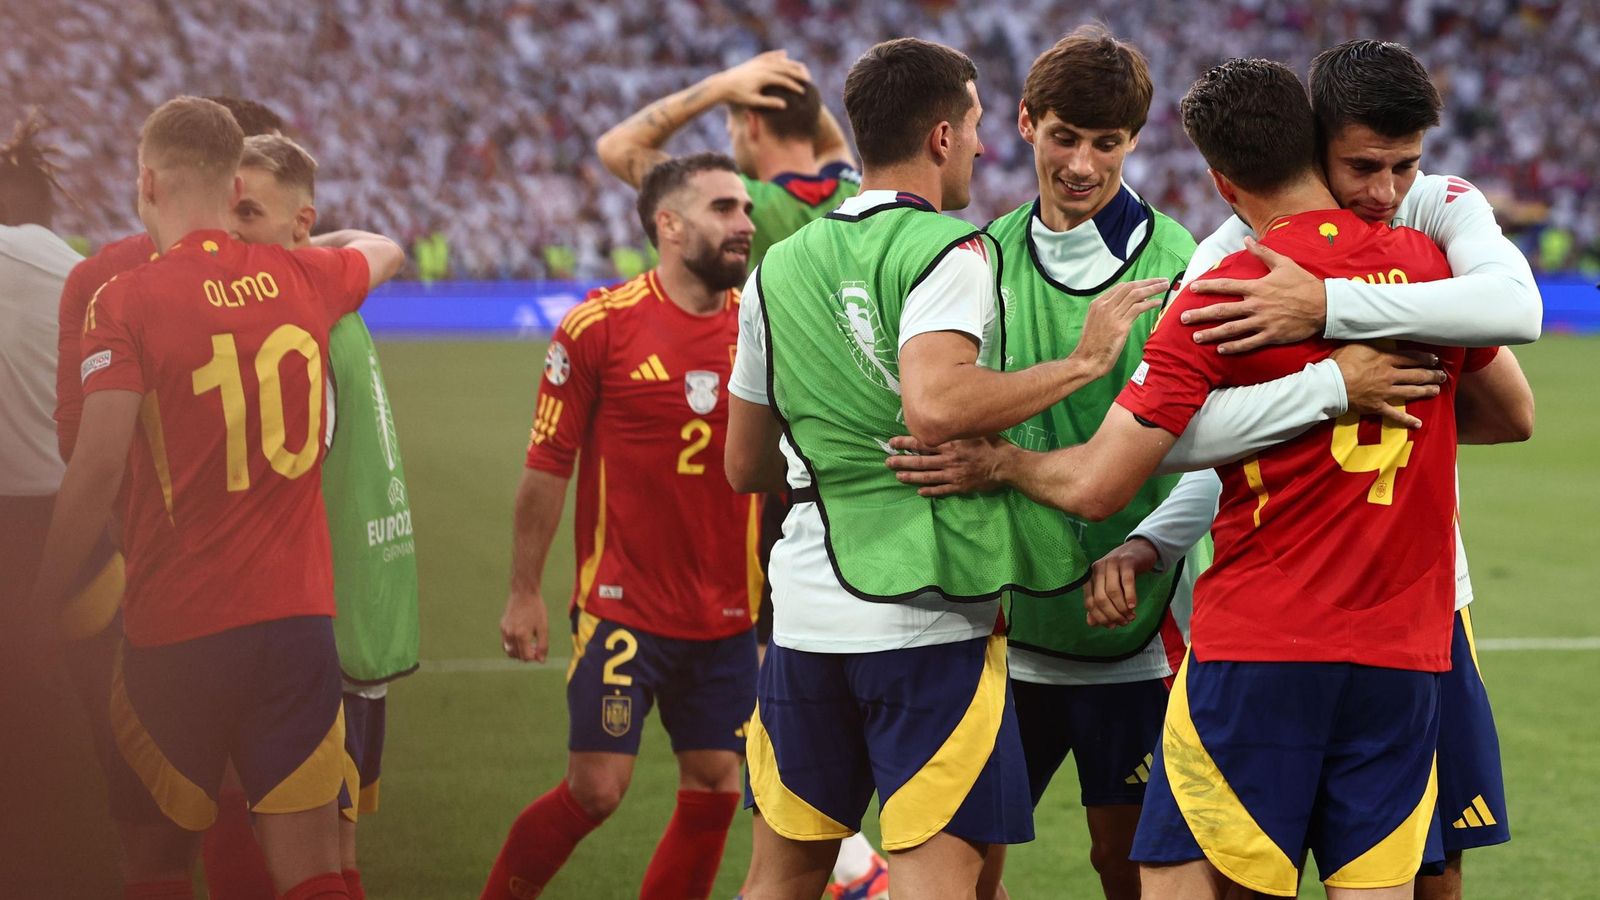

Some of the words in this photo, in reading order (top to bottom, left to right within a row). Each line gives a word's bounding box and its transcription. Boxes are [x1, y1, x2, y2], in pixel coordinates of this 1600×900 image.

[203, 271, 279, 307] OLMO
[191, 323, 322, 492] 10
[677, 418, 712, 475] 2
[1330, 398, 1414, 505] 4
[603, 628, 638, 686] 2
